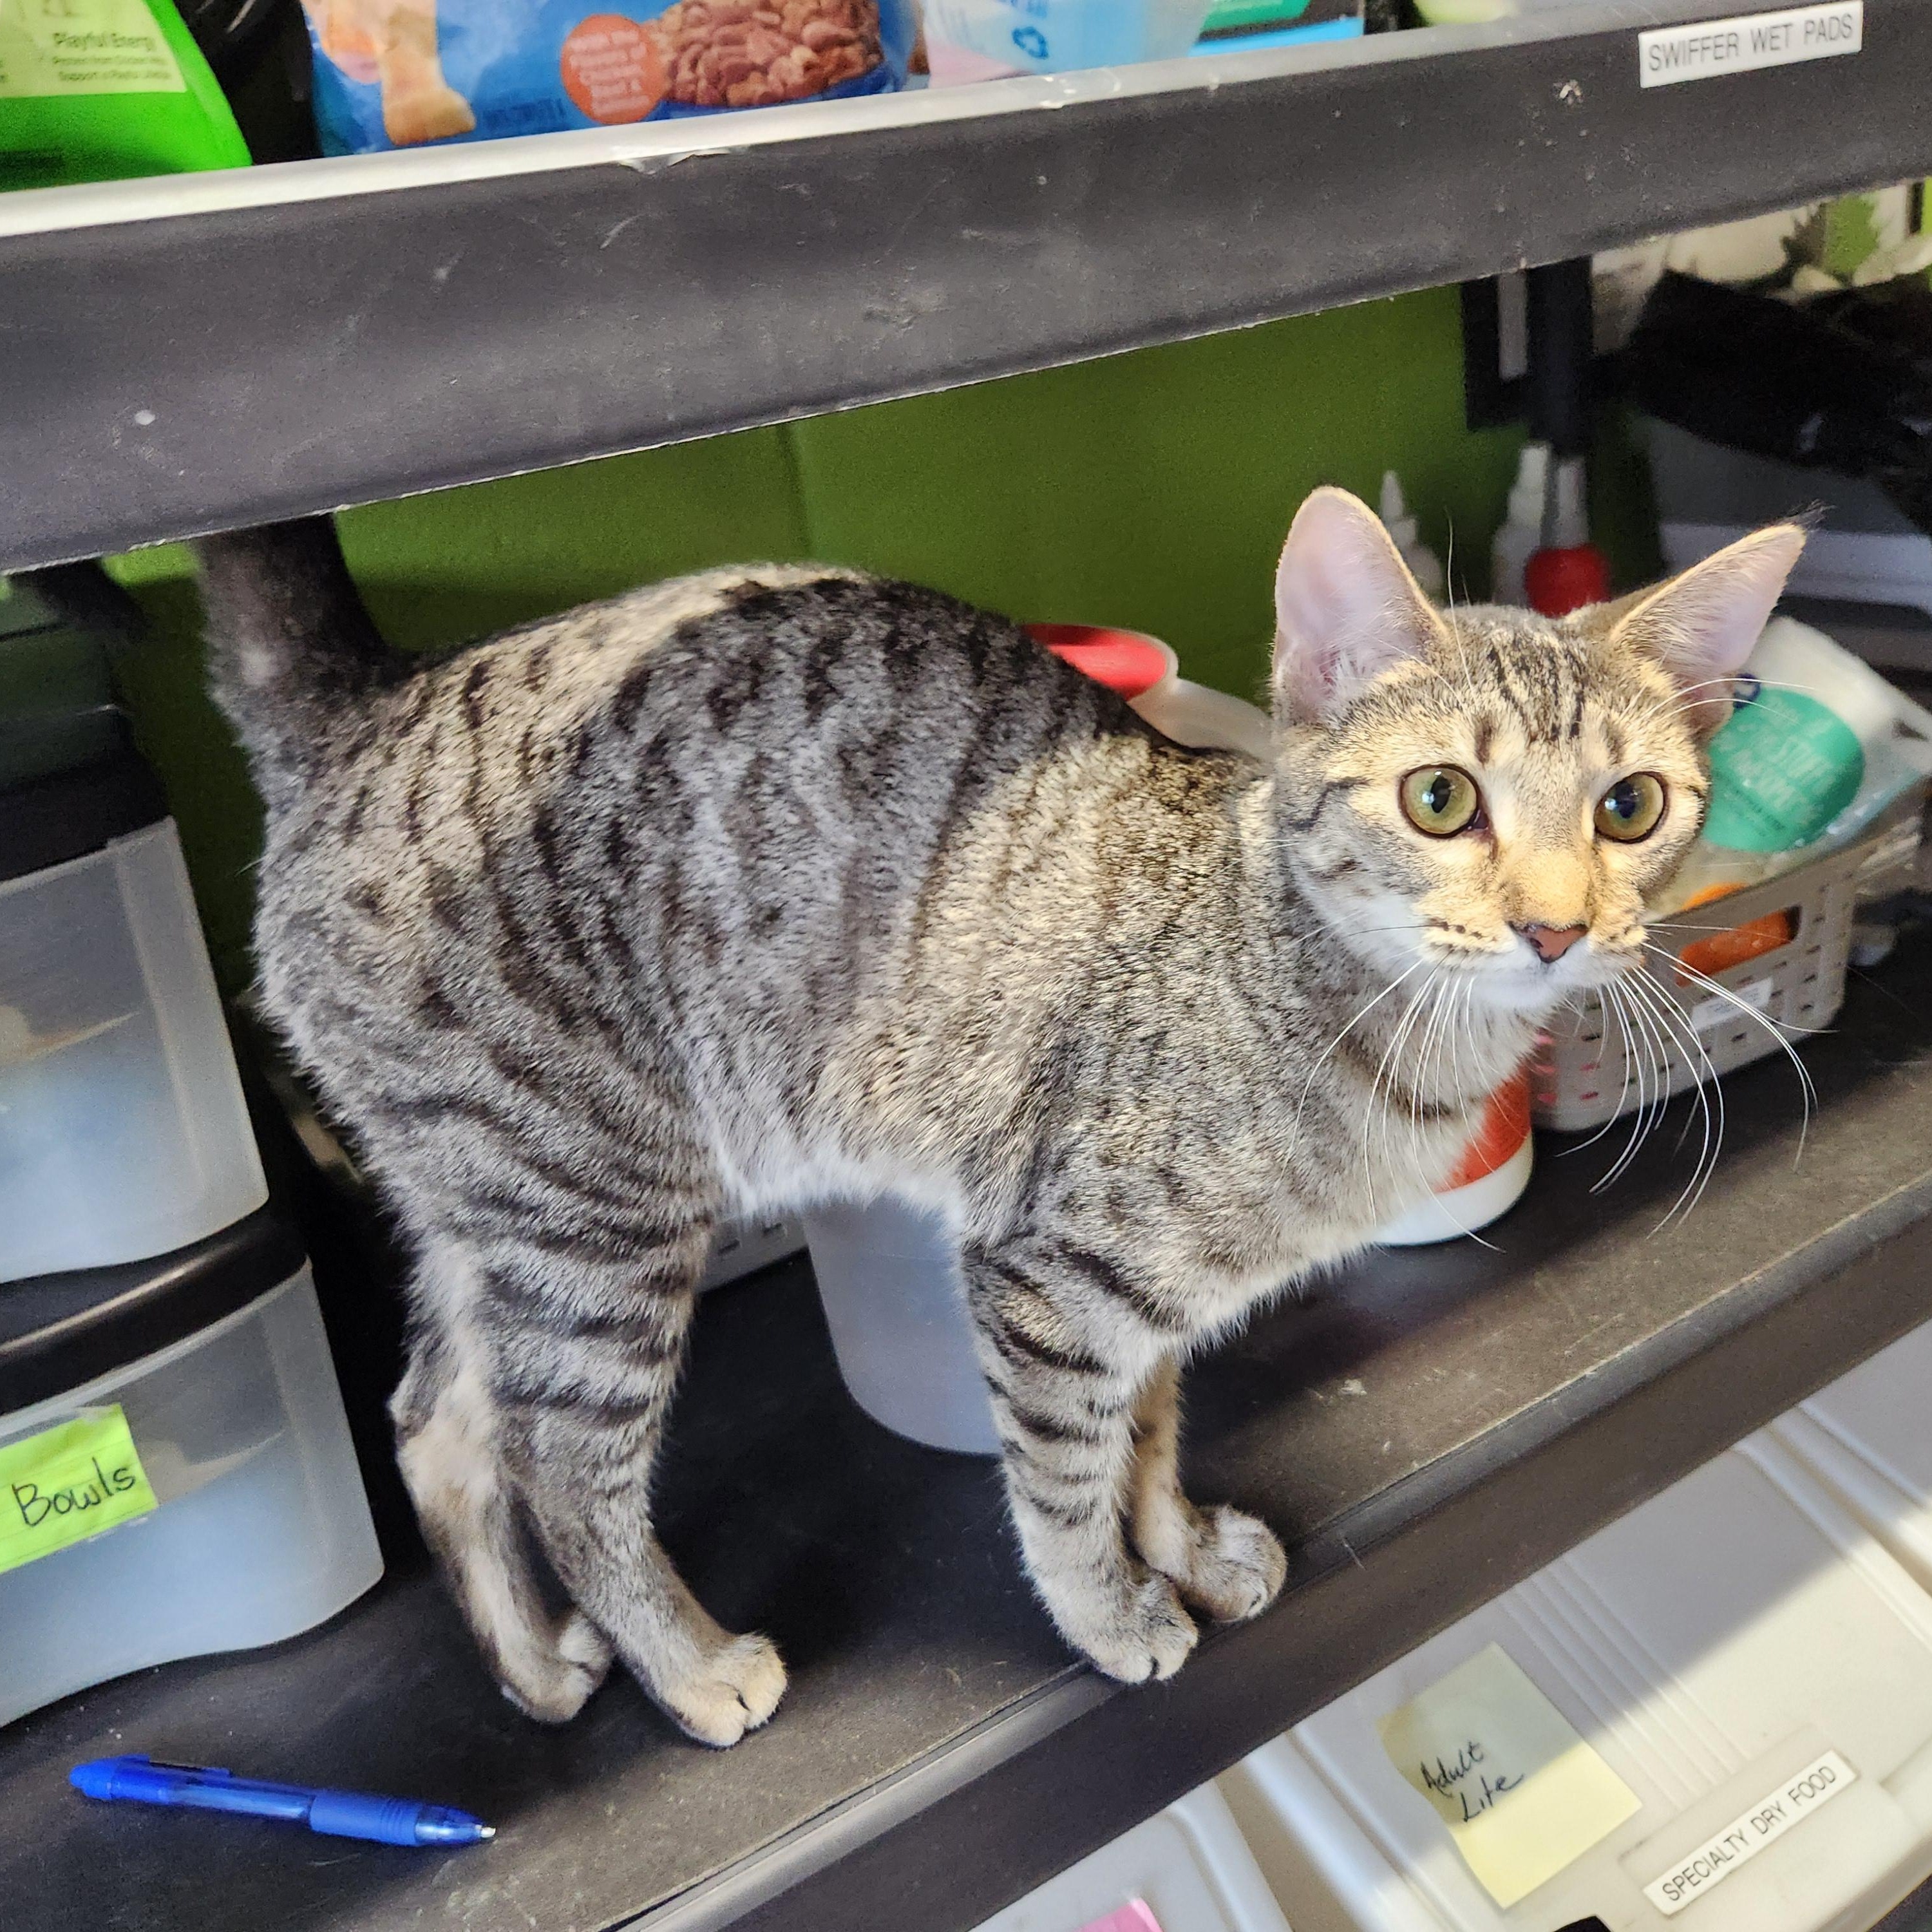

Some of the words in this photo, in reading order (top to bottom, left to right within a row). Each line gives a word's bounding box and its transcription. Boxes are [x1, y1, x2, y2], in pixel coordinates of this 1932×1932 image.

[1647, 32, 1739, 71] SWIFFER
[1750, 23, 1793, 53] WET
[1804, 14, 1853, 44] PADS
[12, 1457, 136, 1527] Bowls
[1420, 1741, 1484, 1798] Adult
[1662, 1828, 1750, 1901] SPECIALTY
[1750, 1799, 1787, 1835] DRY
[1788, 1765, 1837, 1806] FOOD
